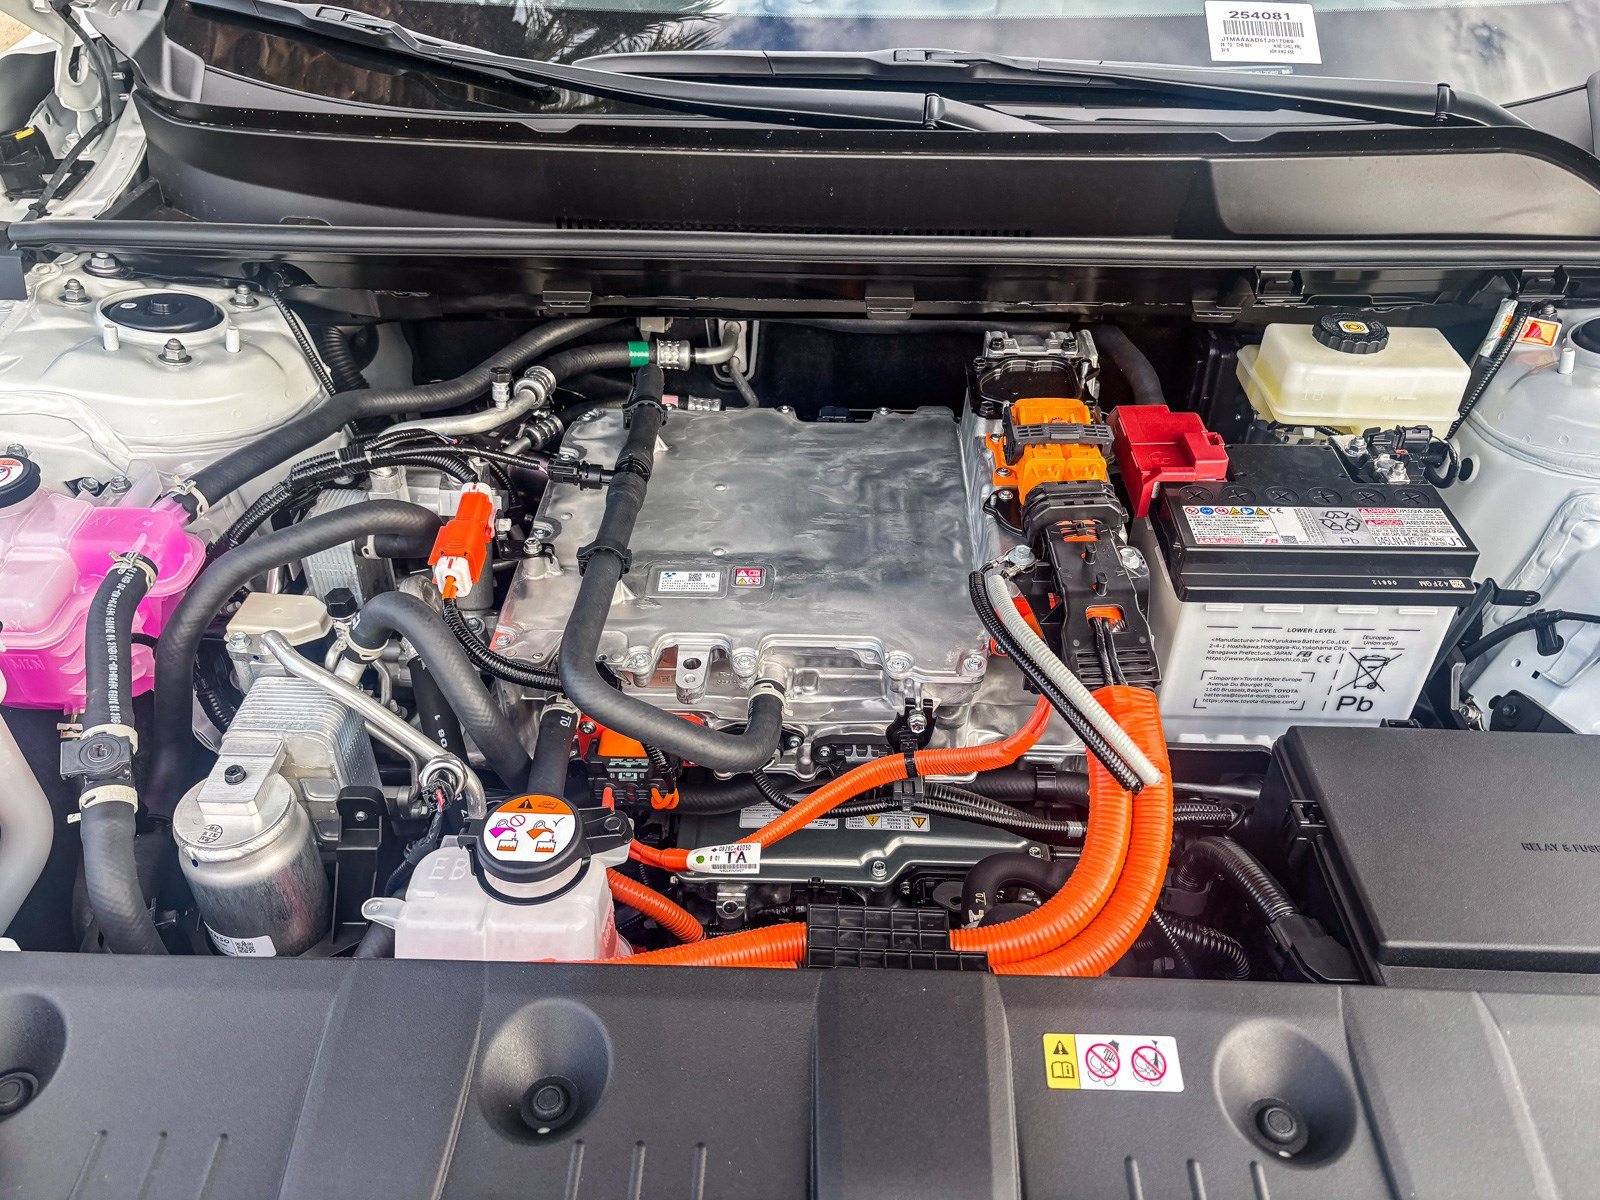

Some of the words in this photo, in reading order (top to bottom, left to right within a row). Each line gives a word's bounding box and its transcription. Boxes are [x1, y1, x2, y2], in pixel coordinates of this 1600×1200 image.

[1228, 10, 1290, 20] 254081
[1340, 537, 1360, 545] Pb
[1448, 537, 1465, 547] J1
[1335, 695, 1374, 712] Pb
[1520, 842, 1559, 851] RELAY
[724, 851, 747, 864] TA
[427, 857, 469, 881] EB
